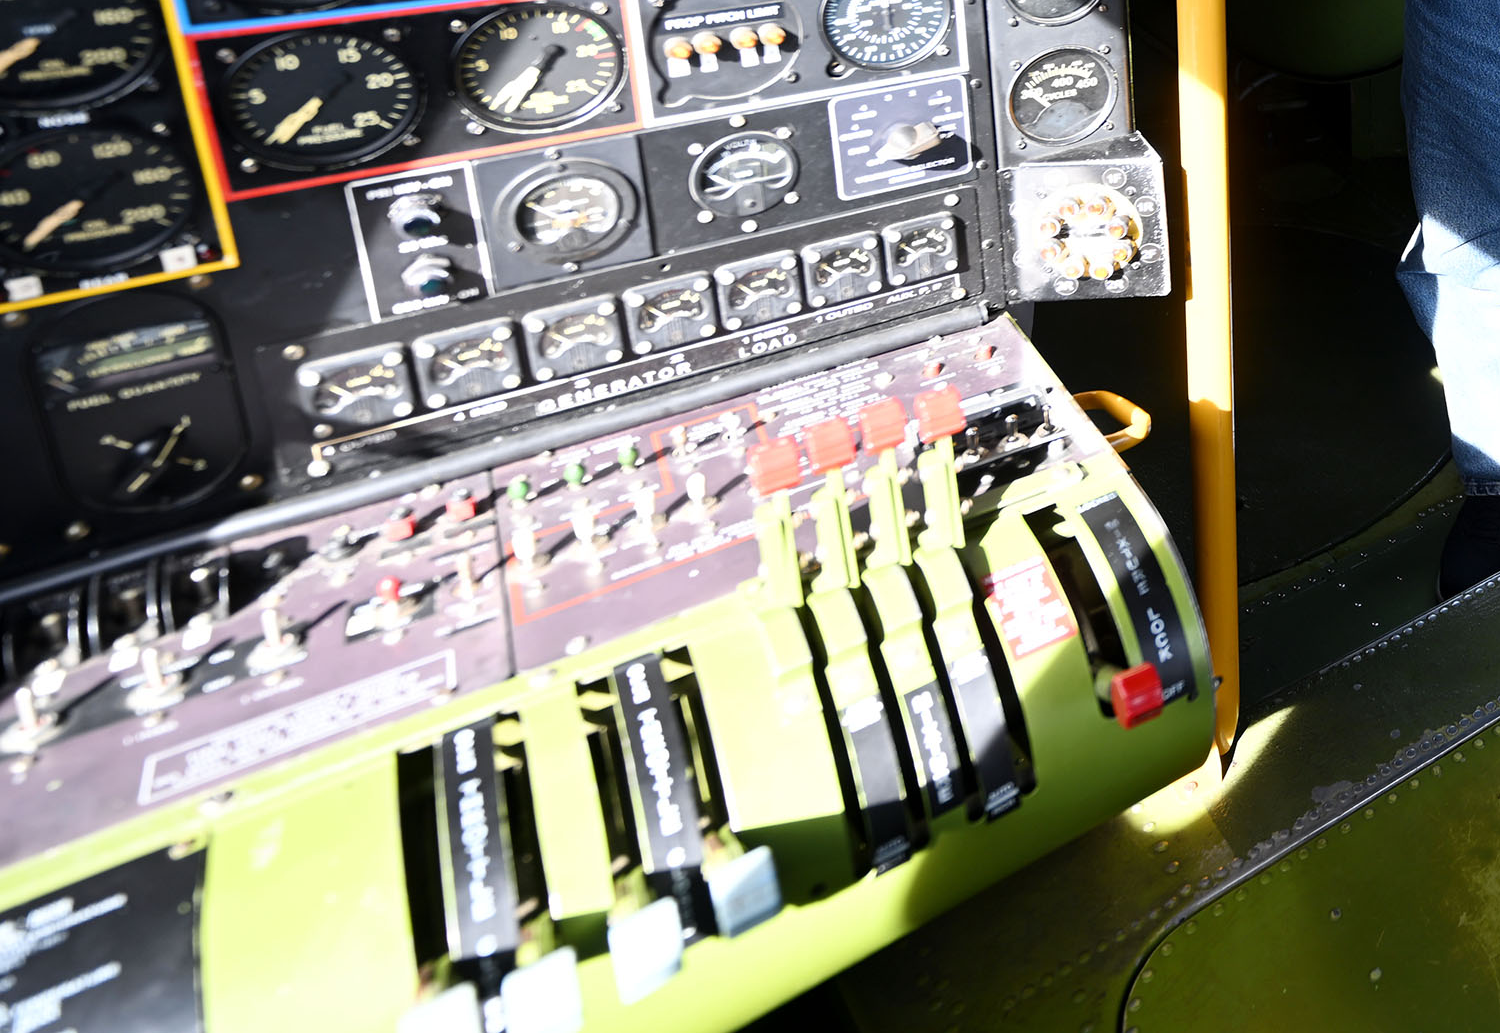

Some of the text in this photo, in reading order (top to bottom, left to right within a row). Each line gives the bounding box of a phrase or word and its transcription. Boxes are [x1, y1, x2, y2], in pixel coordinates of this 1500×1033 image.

[664, 15, 705, 31] PROP
[499, 27, 519, 41] 10
[275, 53, 301, 72] 10
[337, 47, 363, 65] 15
[474, 58, 490, 73] 5
[365, 72, 395, 90] 20
[1051, 75, 1074, 88] 400
[1074, 76, 1099, 89] 450
[248, 87, 267, 105] 5
[1041, 88, 1078, 102] CYCLES
[353, 110, 382, 129] 25
[536, 333, 798, 414] GENERATOR LOAD
[66, 371, 202, 412] FUEL QUANTITY
[1103, 518, 1173, 663] MIXTURE LOCK
[1162, 679, 1185, 701] OFF
